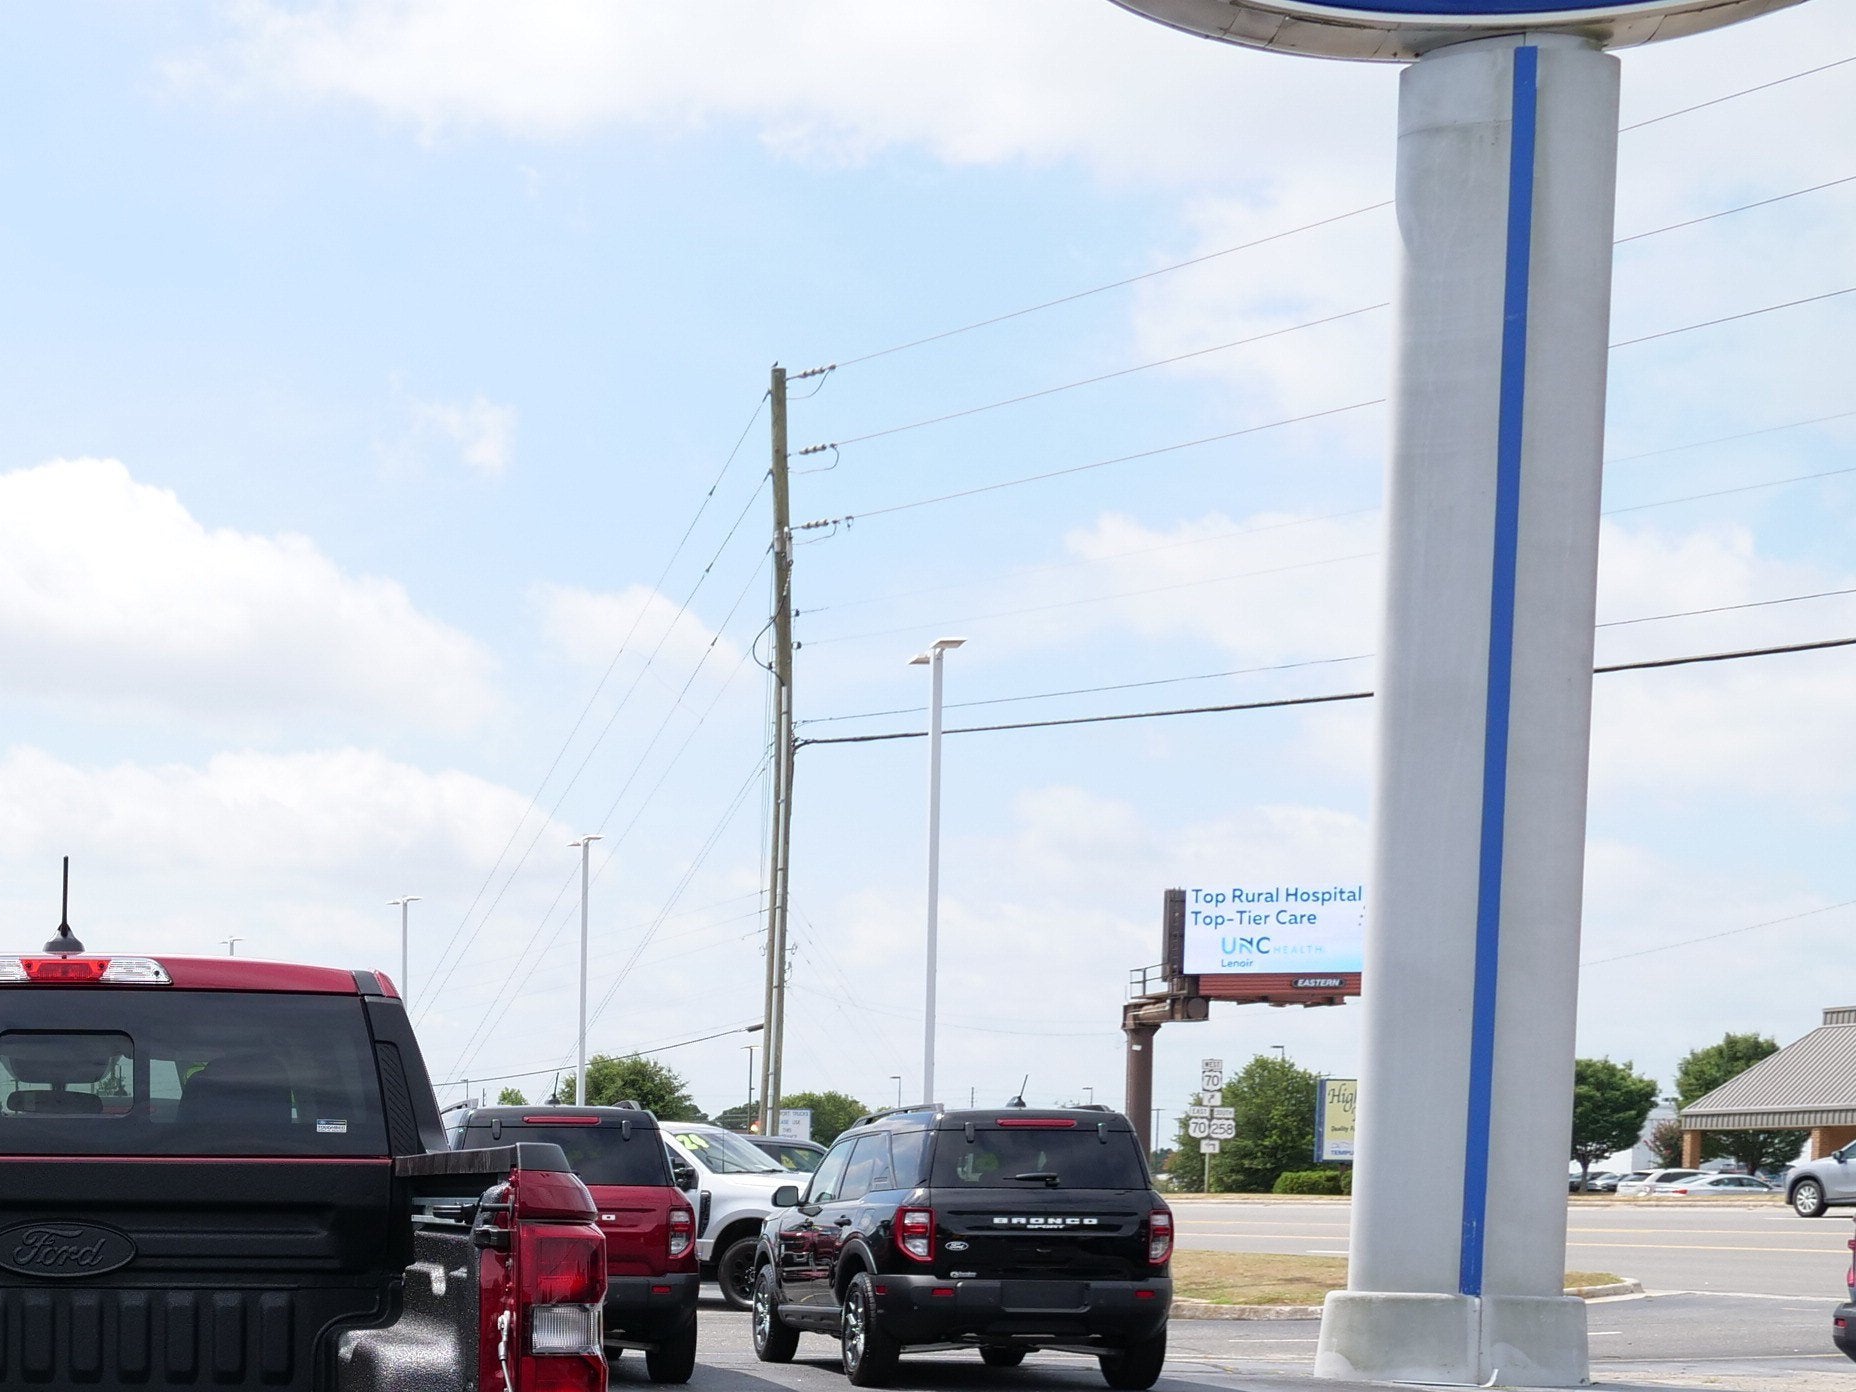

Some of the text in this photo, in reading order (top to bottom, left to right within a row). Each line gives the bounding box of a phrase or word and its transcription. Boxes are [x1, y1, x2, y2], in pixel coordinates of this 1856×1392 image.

[1191, 885, 1362, 907] Top Rural Hospital
[1191, 909, 1317, 930] Top-Tier Care
[1221, 937, 1322, 955] UNC HEALTH
[1221, 959, 1253, 968] Lenoir
[1297, 978, 1340, 987] EASTERN
[1204, 1075, 1220, 1087] 70
[1191, 1122, 1206, 1134] 70
[1211, 1123, 1234, 1135] 258
[993, 1217, 1098, 1225] BRONCO
[12, 1228, 106, 1266] Ford
